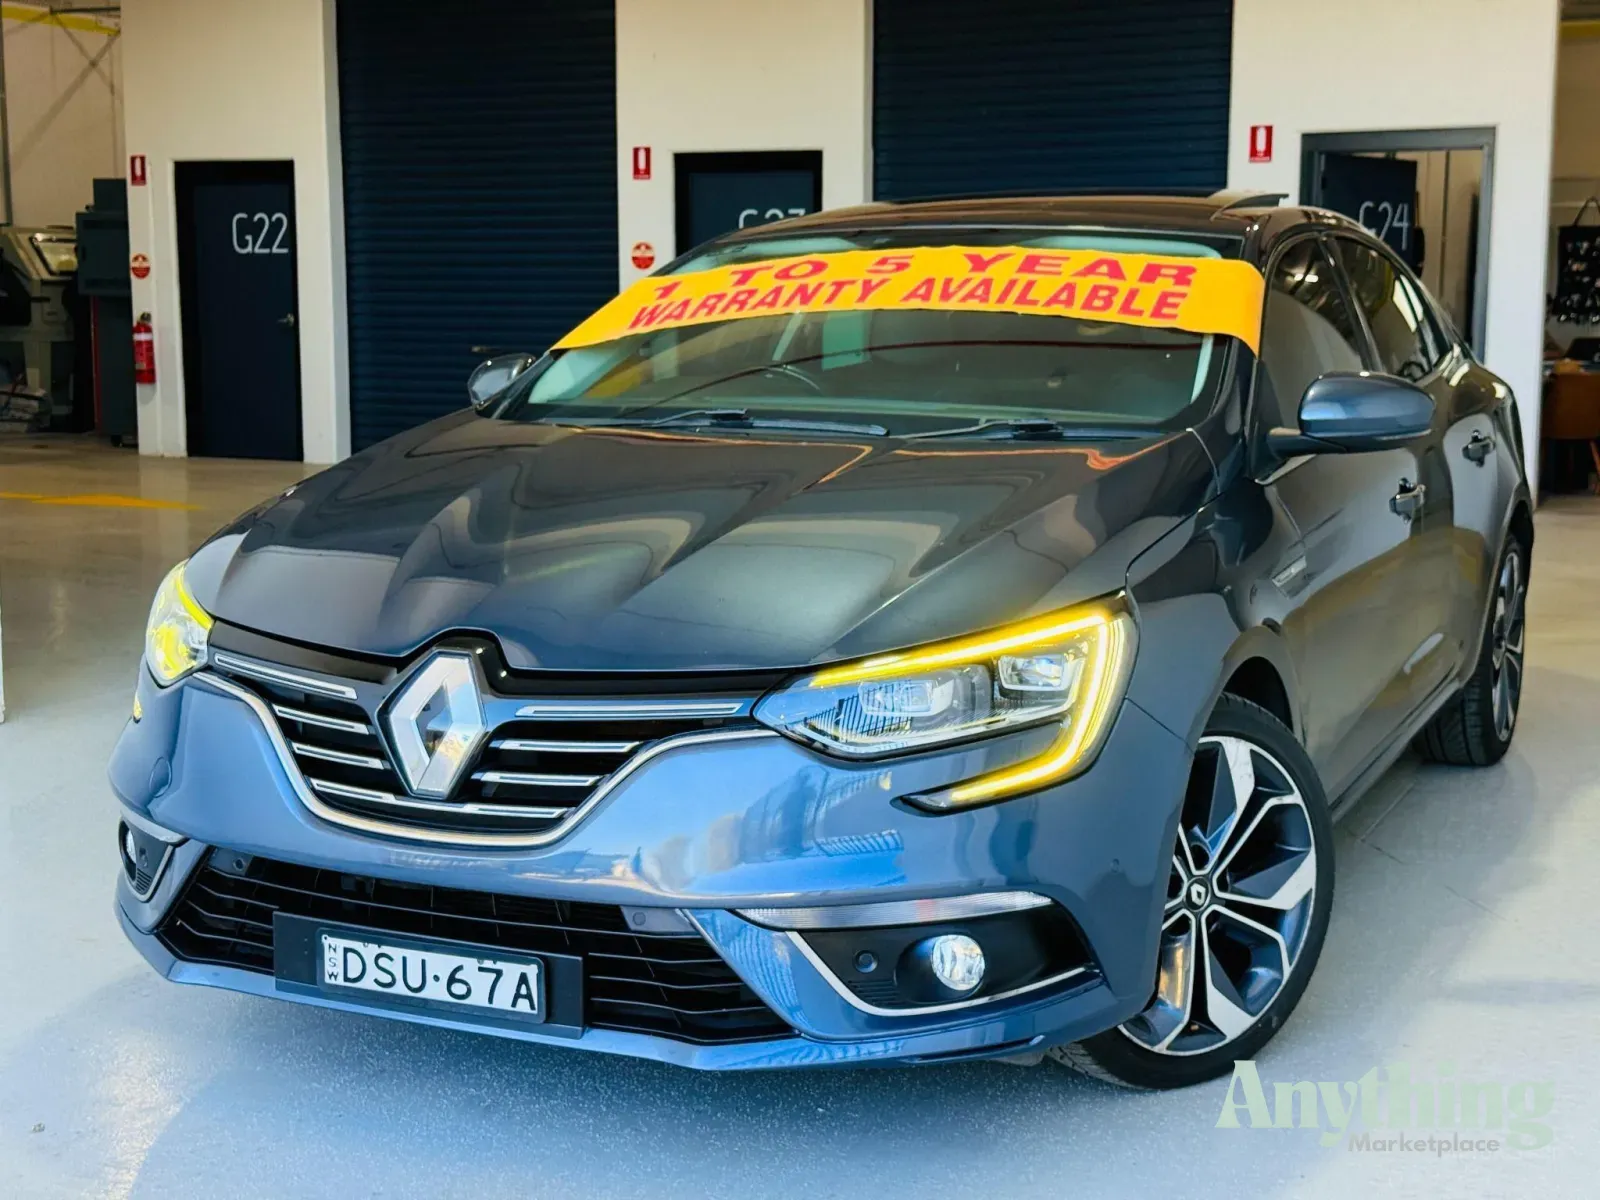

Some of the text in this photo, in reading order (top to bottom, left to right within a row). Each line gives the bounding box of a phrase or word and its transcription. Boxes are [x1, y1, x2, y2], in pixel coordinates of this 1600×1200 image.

[232, 212, 289, 254] G22
[654, 253, 1198, 300] 1 TO 5 YEAR
[627, 277, 1188, 331] WARRANTY AVAILABLE
[327, 942, 339, 982] NSW
